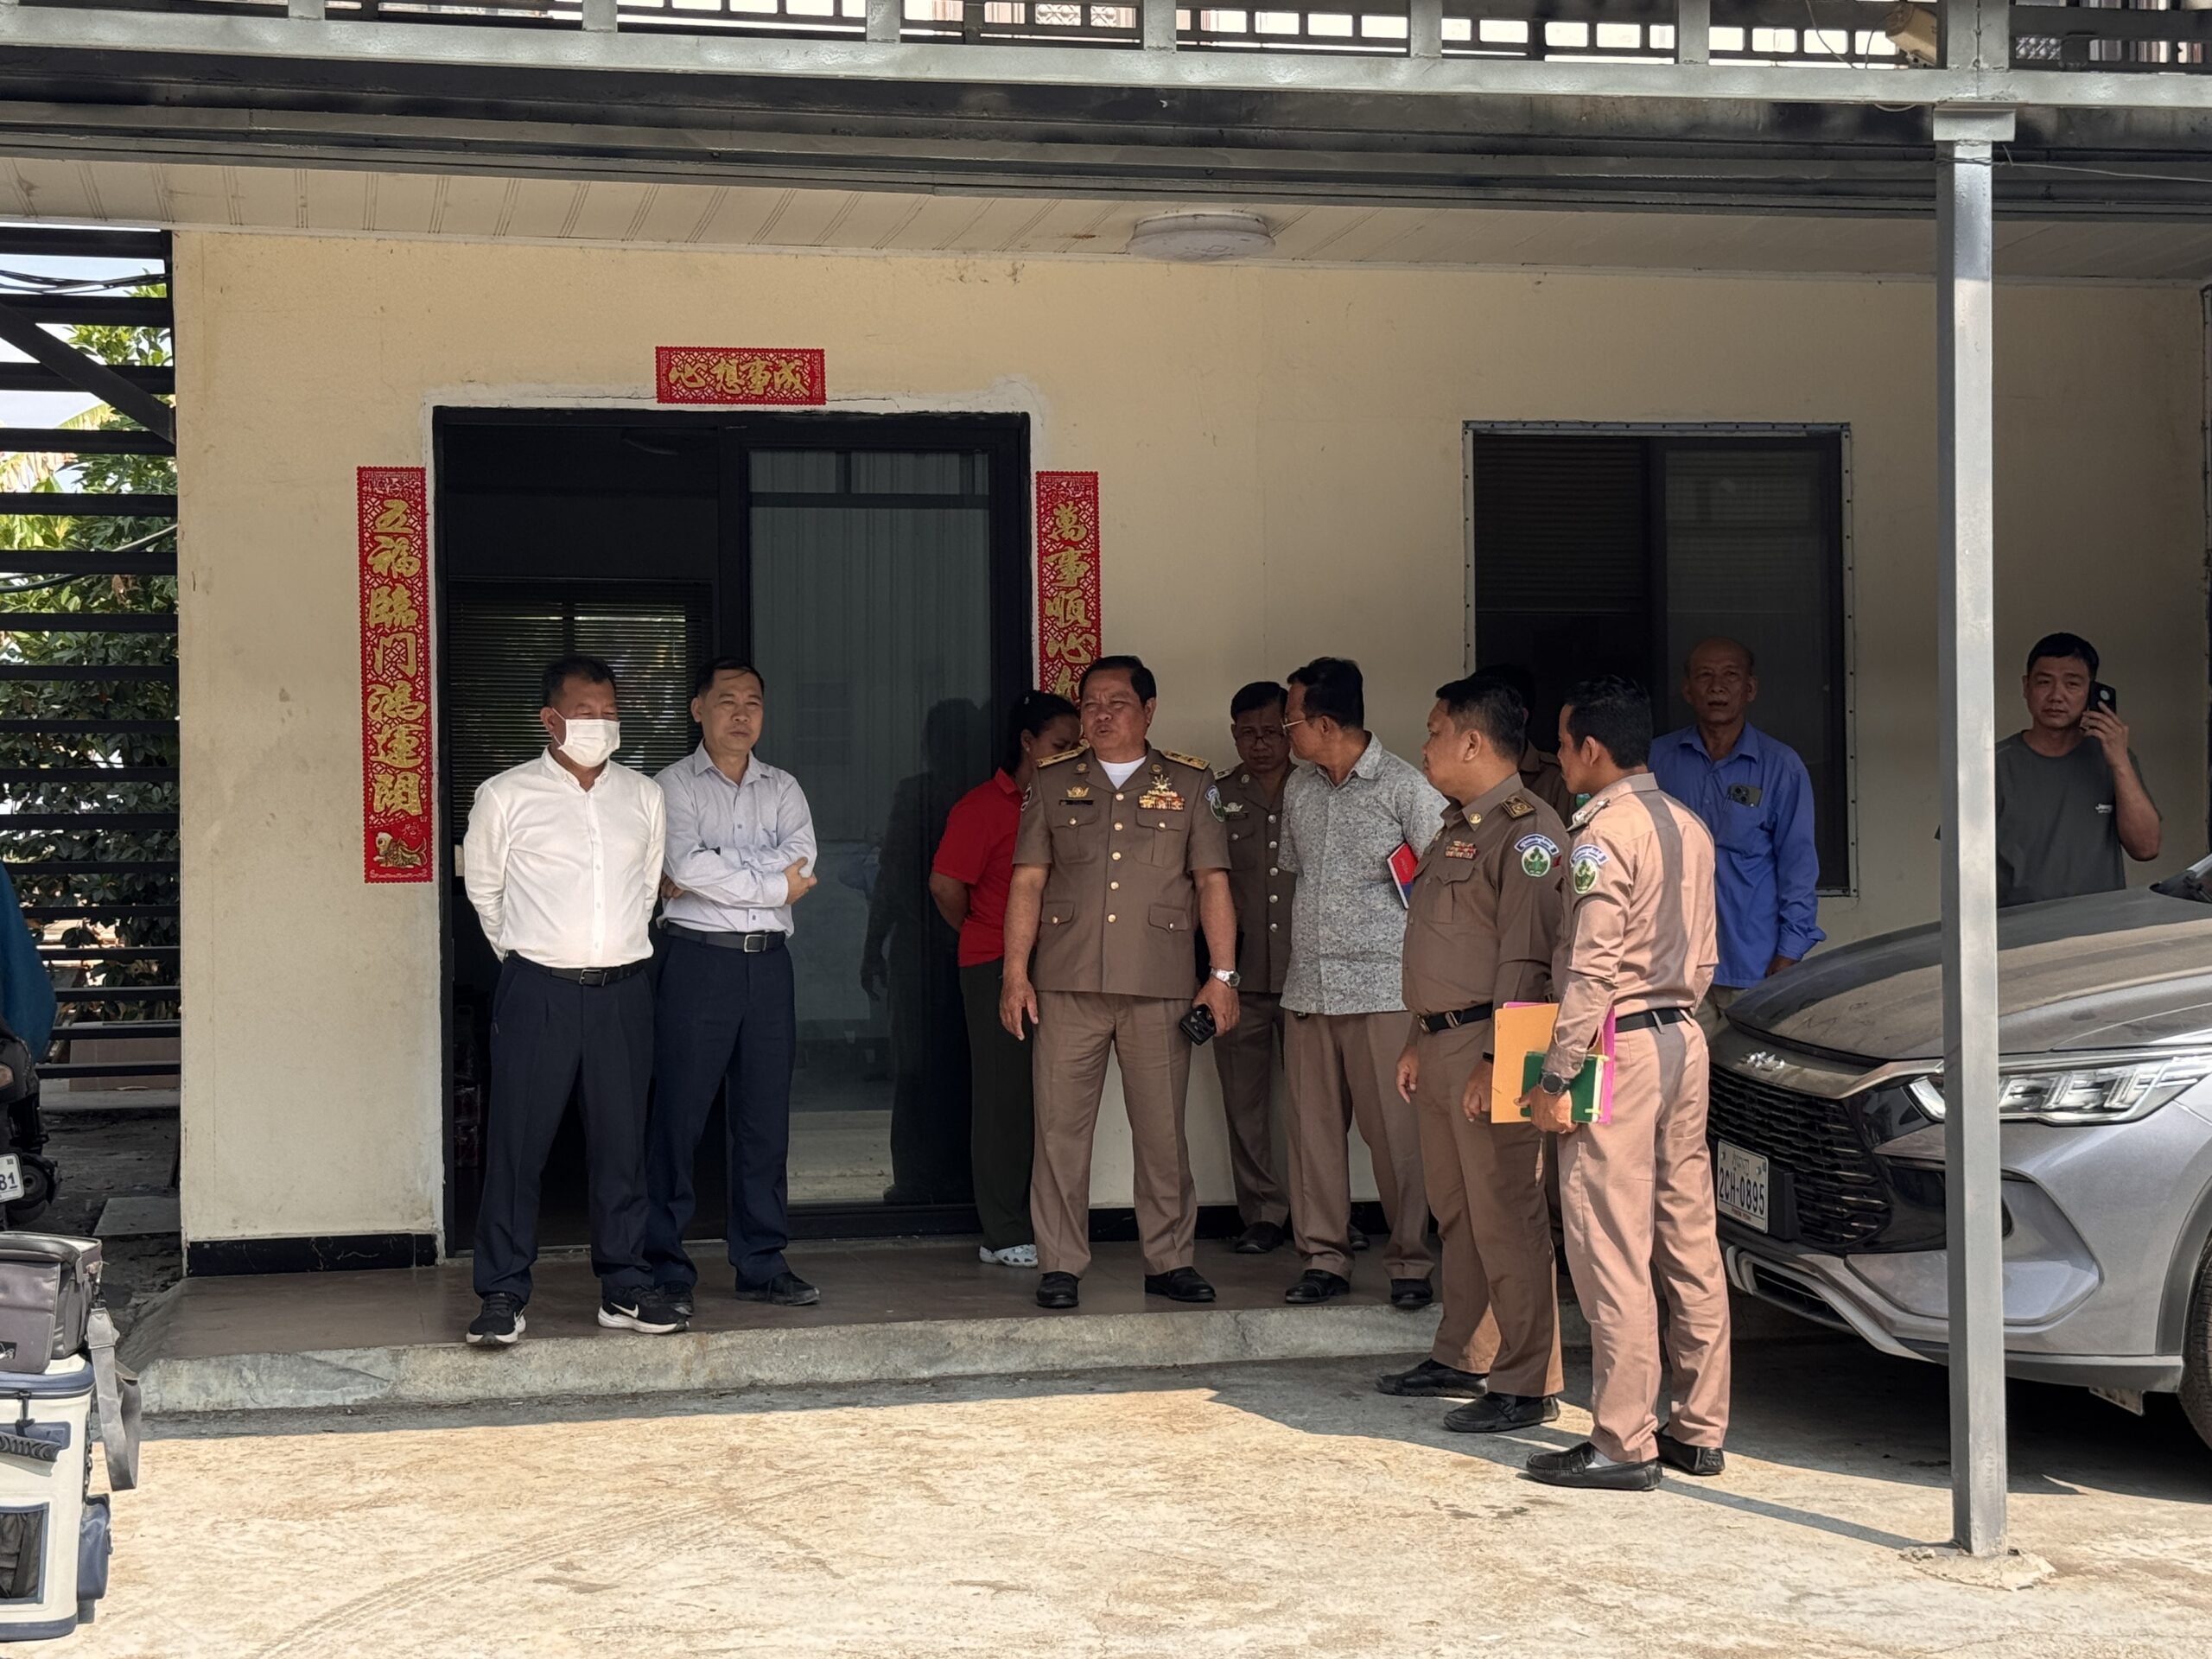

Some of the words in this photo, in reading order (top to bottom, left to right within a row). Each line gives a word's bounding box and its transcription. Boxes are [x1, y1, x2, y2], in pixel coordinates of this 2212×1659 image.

[669, 355, 810, 397] 心想事成
[1719, 1166, 1765, 1216] 2CH-0895
